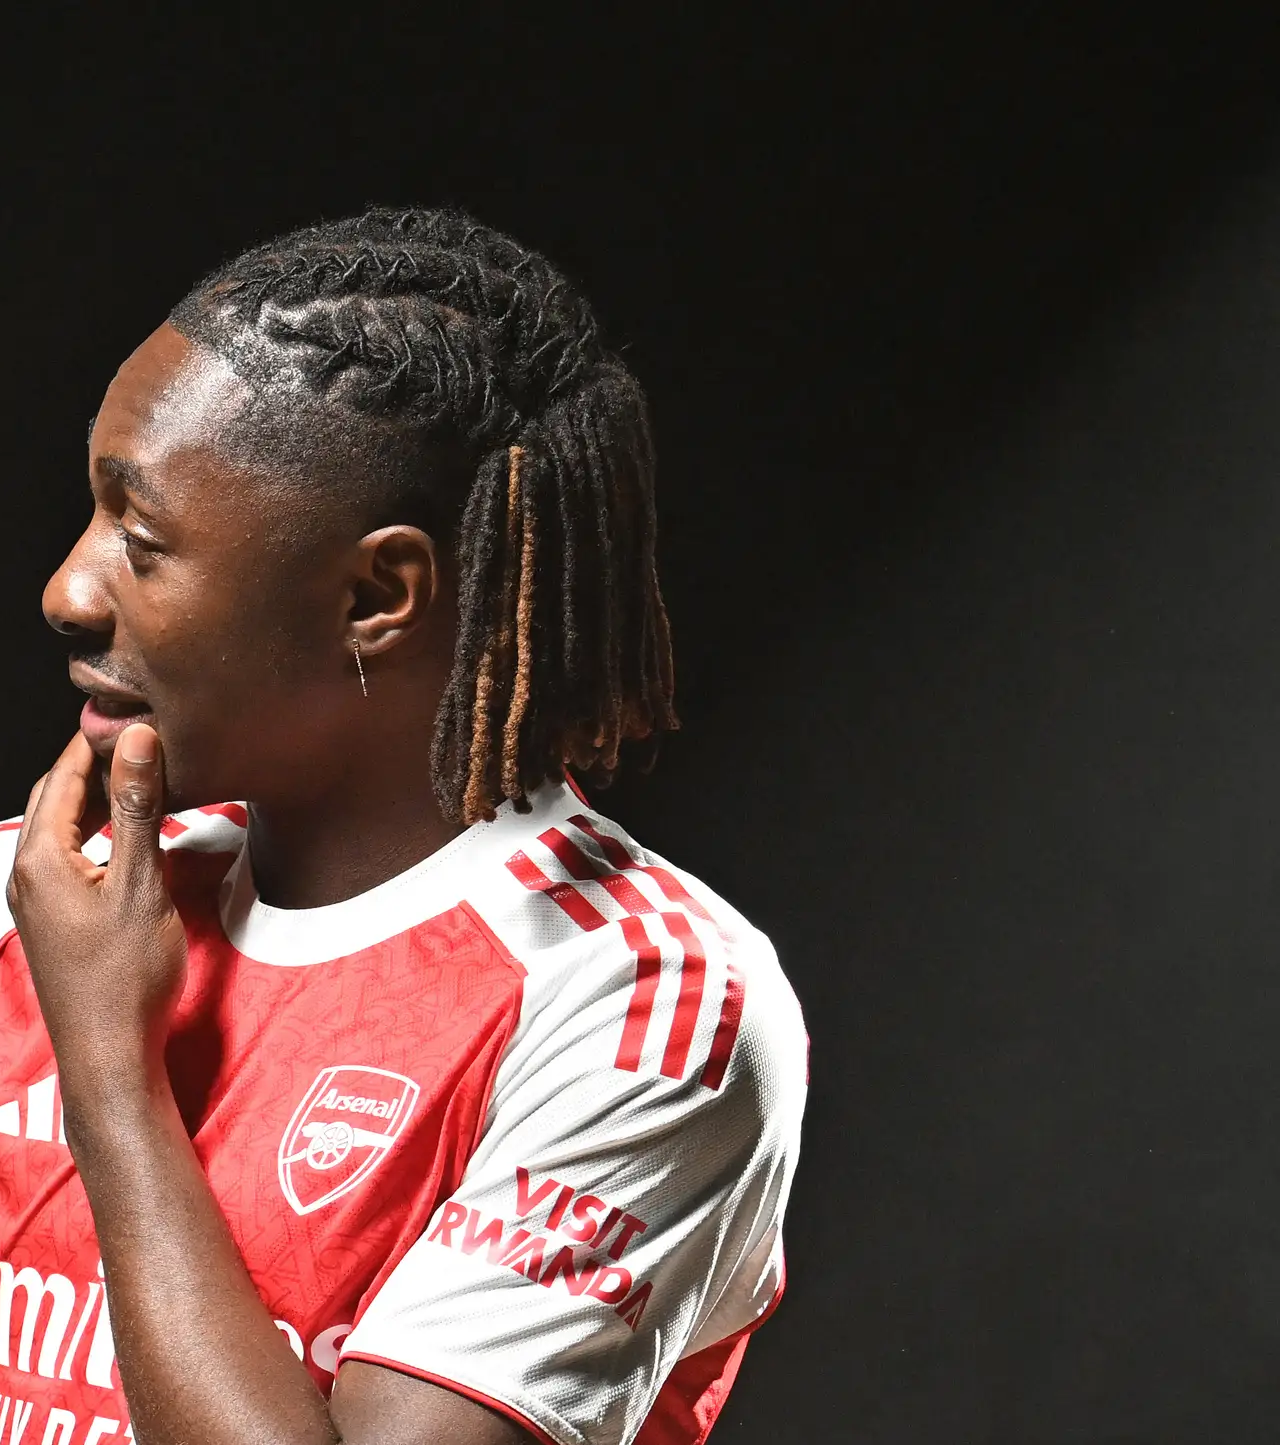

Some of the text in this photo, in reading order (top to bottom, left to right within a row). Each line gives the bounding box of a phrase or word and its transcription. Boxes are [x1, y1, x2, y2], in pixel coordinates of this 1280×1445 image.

[317, 1089, 399, 1119] Arsenal
[516, 1166, 648, 1260] VISIT
[428, 1201, 654, 1332] RWANDA
